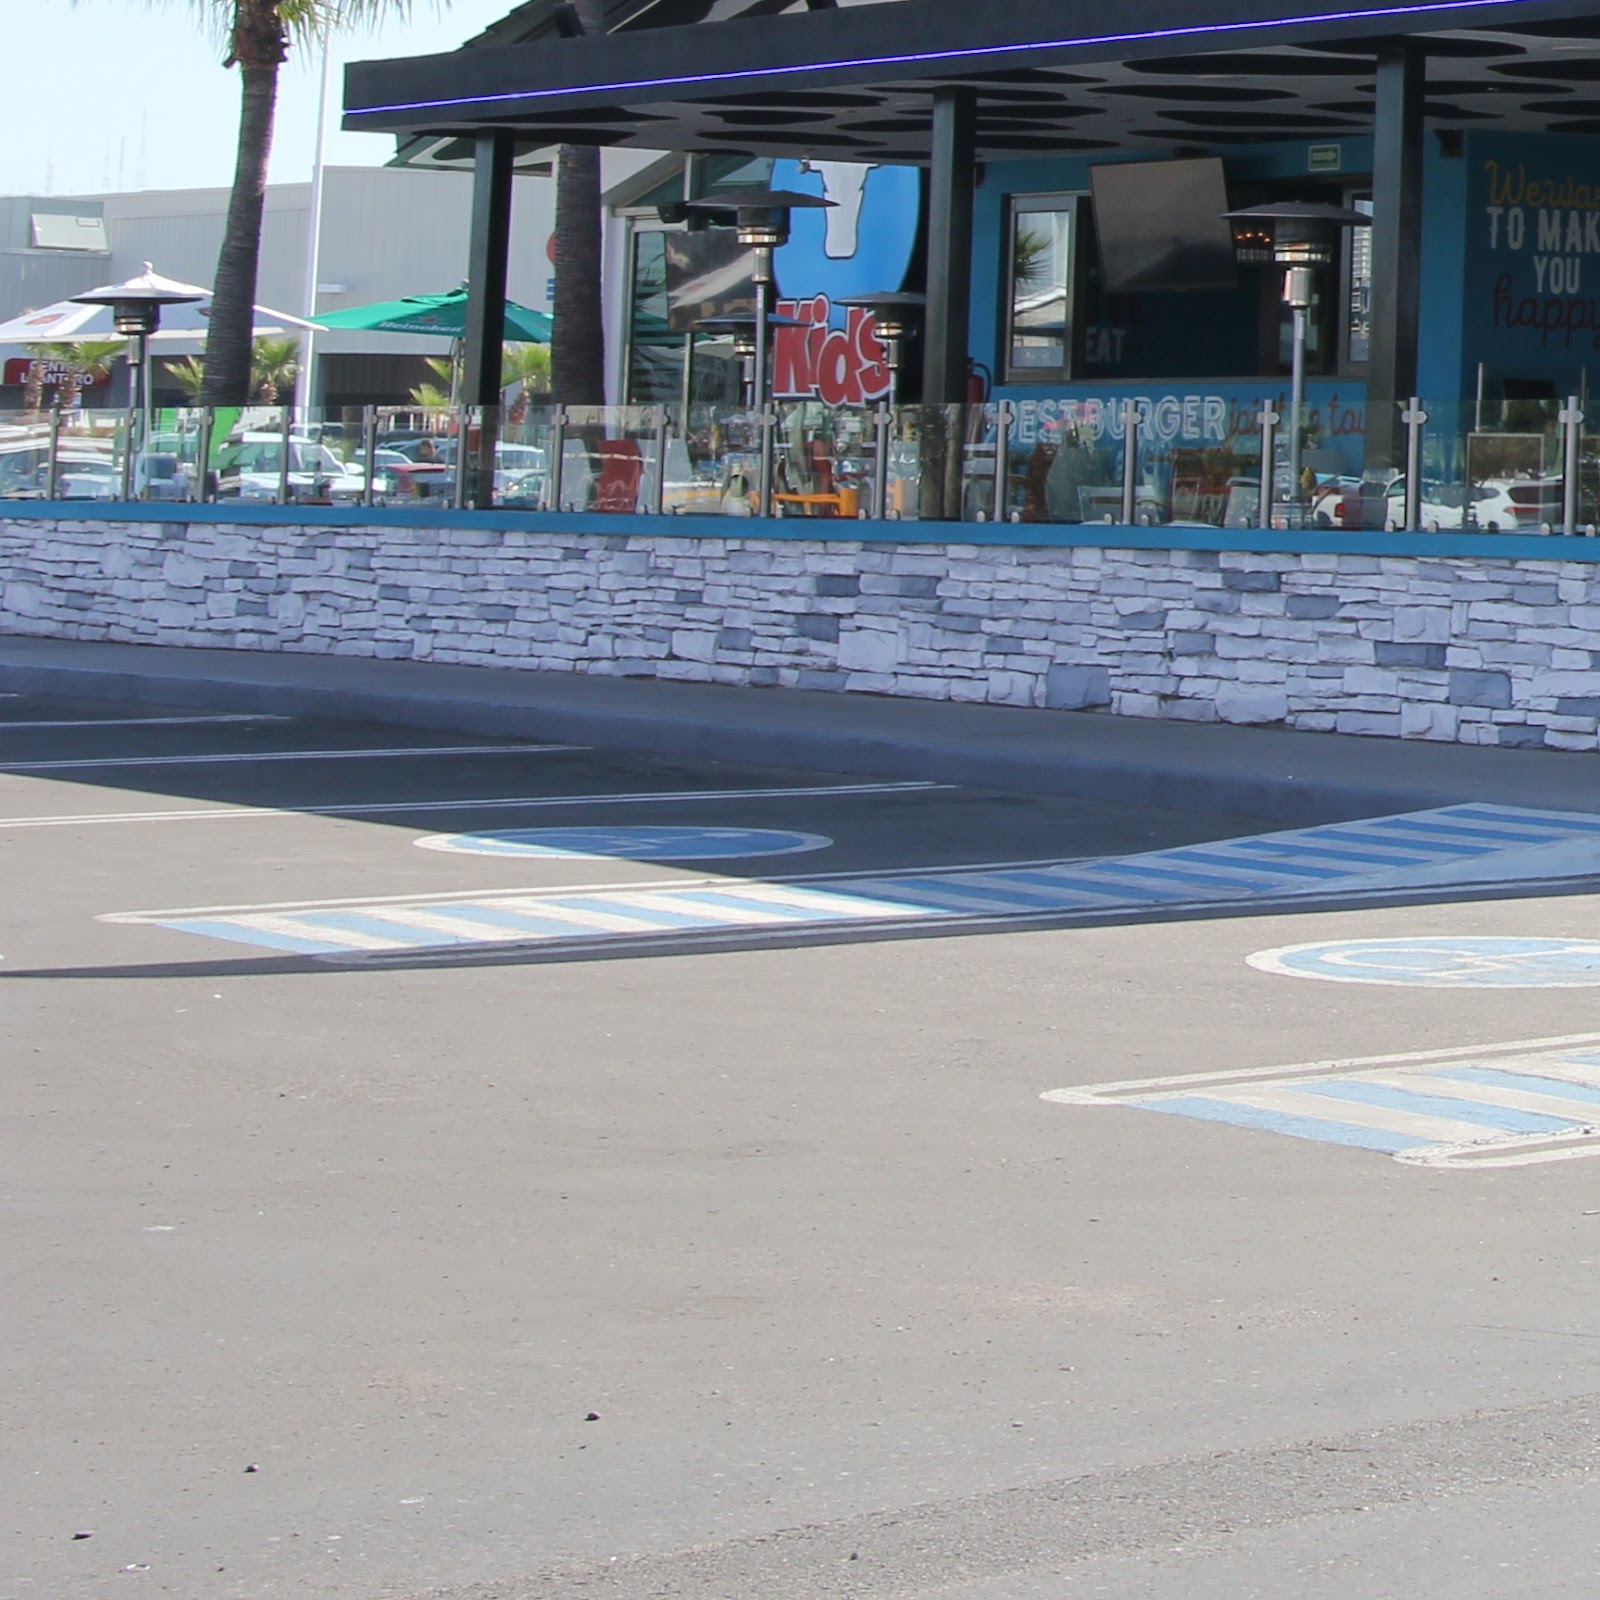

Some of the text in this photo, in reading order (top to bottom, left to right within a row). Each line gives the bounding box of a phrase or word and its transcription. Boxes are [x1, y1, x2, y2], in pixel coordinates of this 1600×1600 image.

[1486, 206, 1527, 250] TO
[1533, 256, 1580, 294] YOU
[773, 295, 890, 406] Kids
[1086, 394, 1227, 441] BURGER
